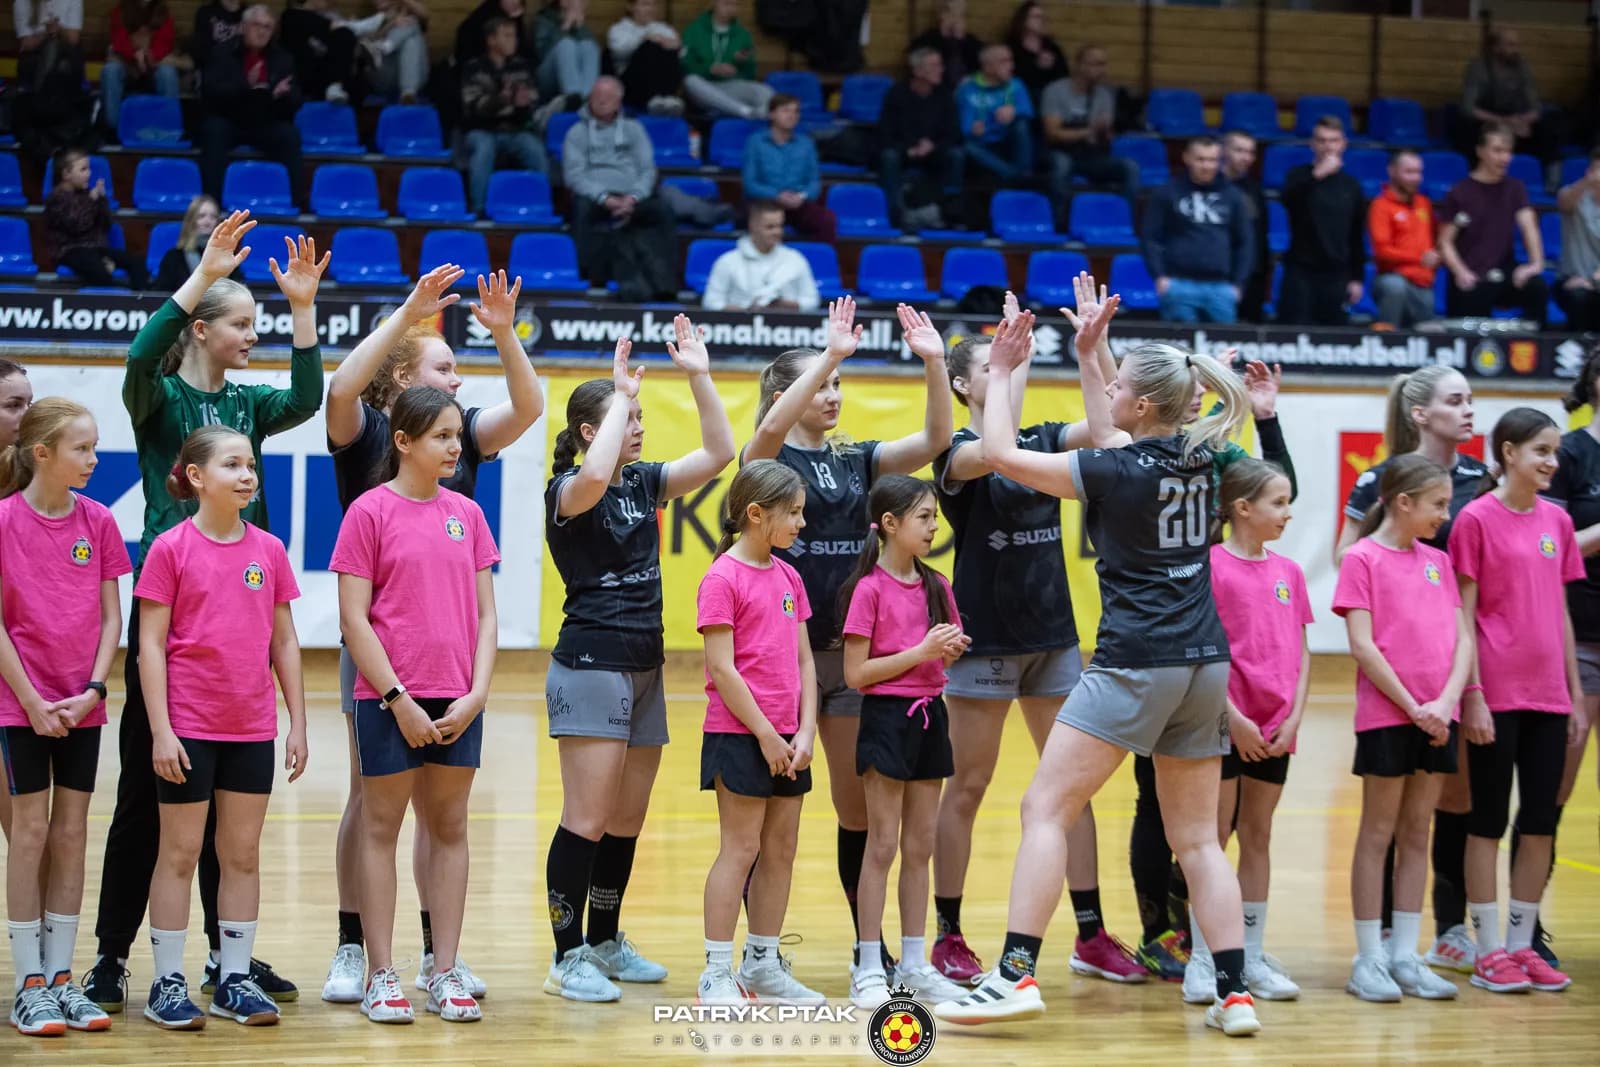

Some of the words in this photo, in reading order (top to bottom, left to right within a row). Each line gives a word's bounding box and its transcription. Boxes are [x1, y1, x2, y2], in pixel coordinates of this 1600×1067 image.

[810, 461, 838, 489] 13
[617, 496, 646, 525] 14
[1157, 475, 1209, 549] 20
[810, 541, 865, 555] SUZU
[1012, 526, 1062, 546] SUZU
